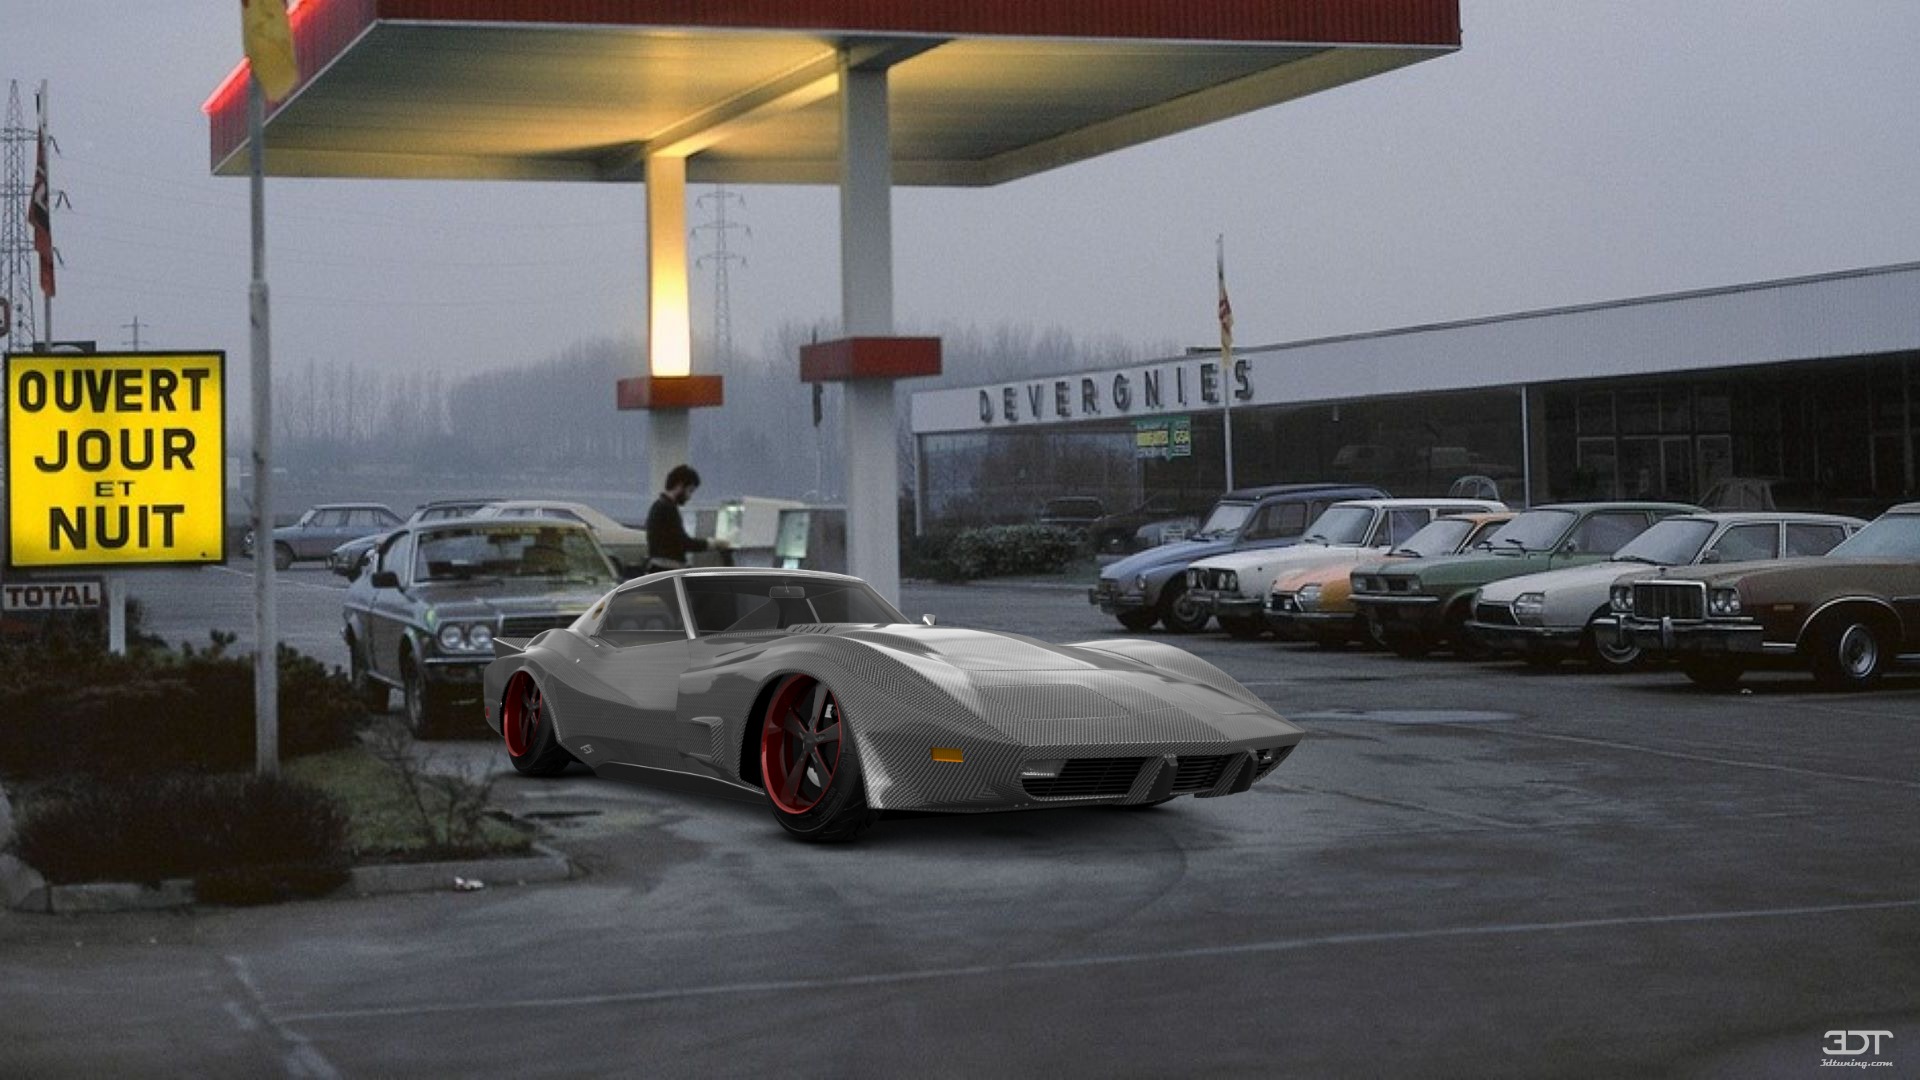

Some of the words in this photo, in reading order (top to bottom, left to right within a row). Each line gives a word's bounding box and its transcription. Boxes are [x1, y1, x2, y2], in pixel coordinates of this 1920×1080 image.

[19, 368, 210, 413] OUVERT
[979, 359, 1253, 423] DEVERGNIES
[34, 428, 196, 473] JOUR
[94, 480, 136, 497] ET
[49, 504, 185, 550] NUIT
[5, 585, 97, 607] TOTAL
